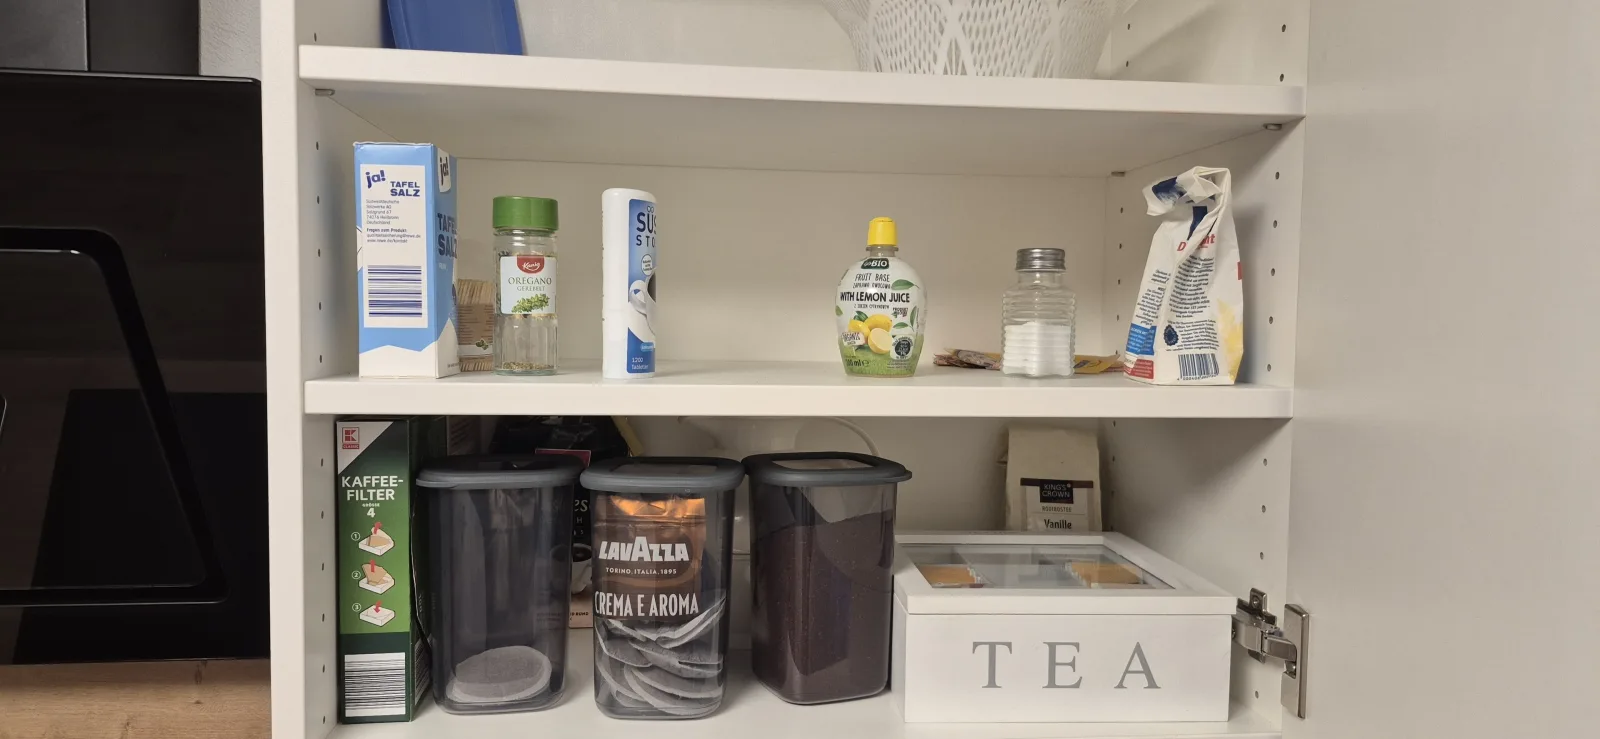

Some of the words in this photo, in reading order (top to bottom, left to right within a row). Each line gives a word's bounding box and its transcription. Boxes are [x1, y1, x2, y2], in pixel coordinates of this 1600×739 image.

[365, 170, 386, 189] ja!
[390, 189, 420, 197] SALZ
[508, 277, 552, 285] OREGANO
[855, 273, 872, 281] FRUIT
[875, 274, 890, 282] BASE
[840, 292, 855, 301] WITH
[856, 292, 887, 302] LEMON
[889, 293, 910, 303] JUICE
[342, 476, 404, 488] KAFFEE-
[346, 490, 395, 501] FILTER
[367, 508, 375, 518] 4
[1044, 518, 1072, 530] Vanille
[598, 536, 690, 562] LAVAZZA
[594, 590, 634, 617] CREMA
[637, 594, 646, 617] E
[648, 592, 700, 617] AROMA
[972, 641, 1162, 689] TEA
